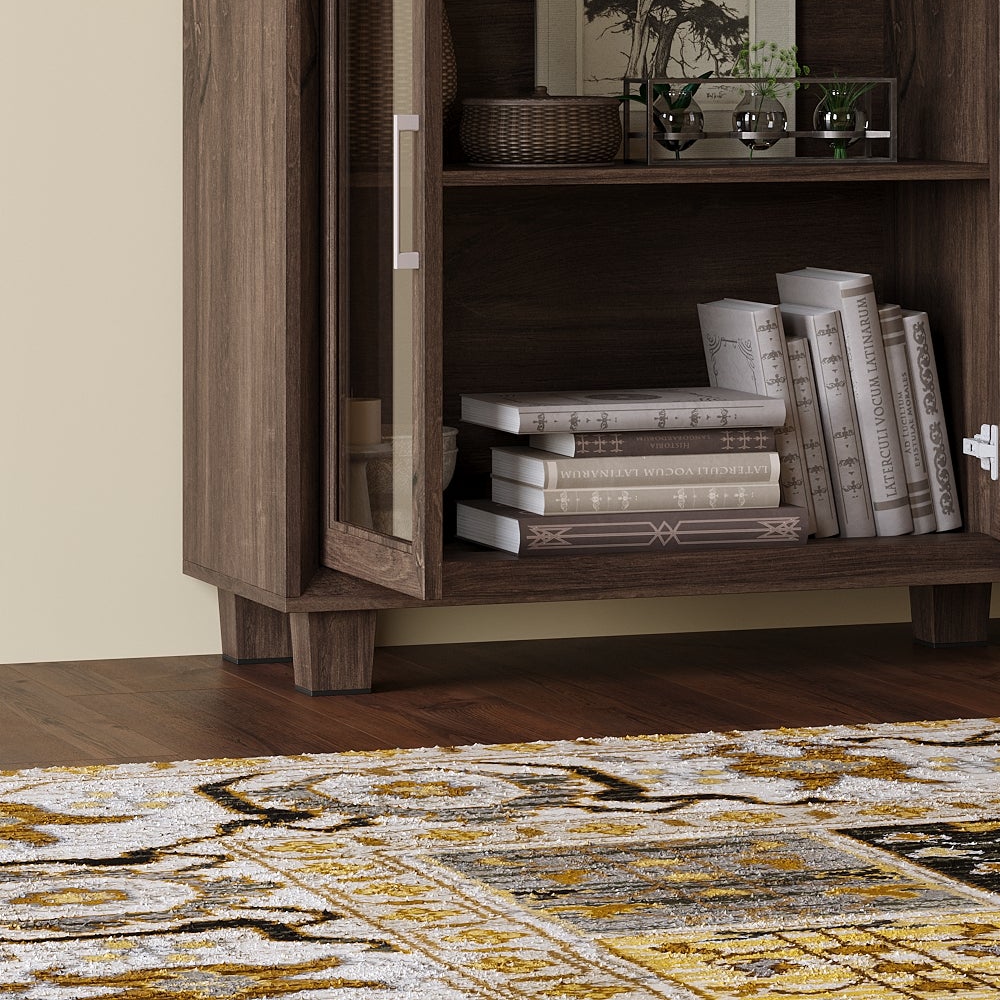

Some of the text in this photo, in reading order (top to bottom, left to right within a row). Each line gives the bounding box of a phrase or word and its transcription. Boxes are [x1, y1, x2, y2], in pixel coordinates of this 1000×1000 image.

[856, 296, 897, 498] LATERCULI VOCUM LATINARUM
[901, 372, 913, 416] MORALES
[897, 392, 912, 454] AD LUCILIUM
[560, 465, 769, 478] LATERCULI VOCUM LATINARUM
